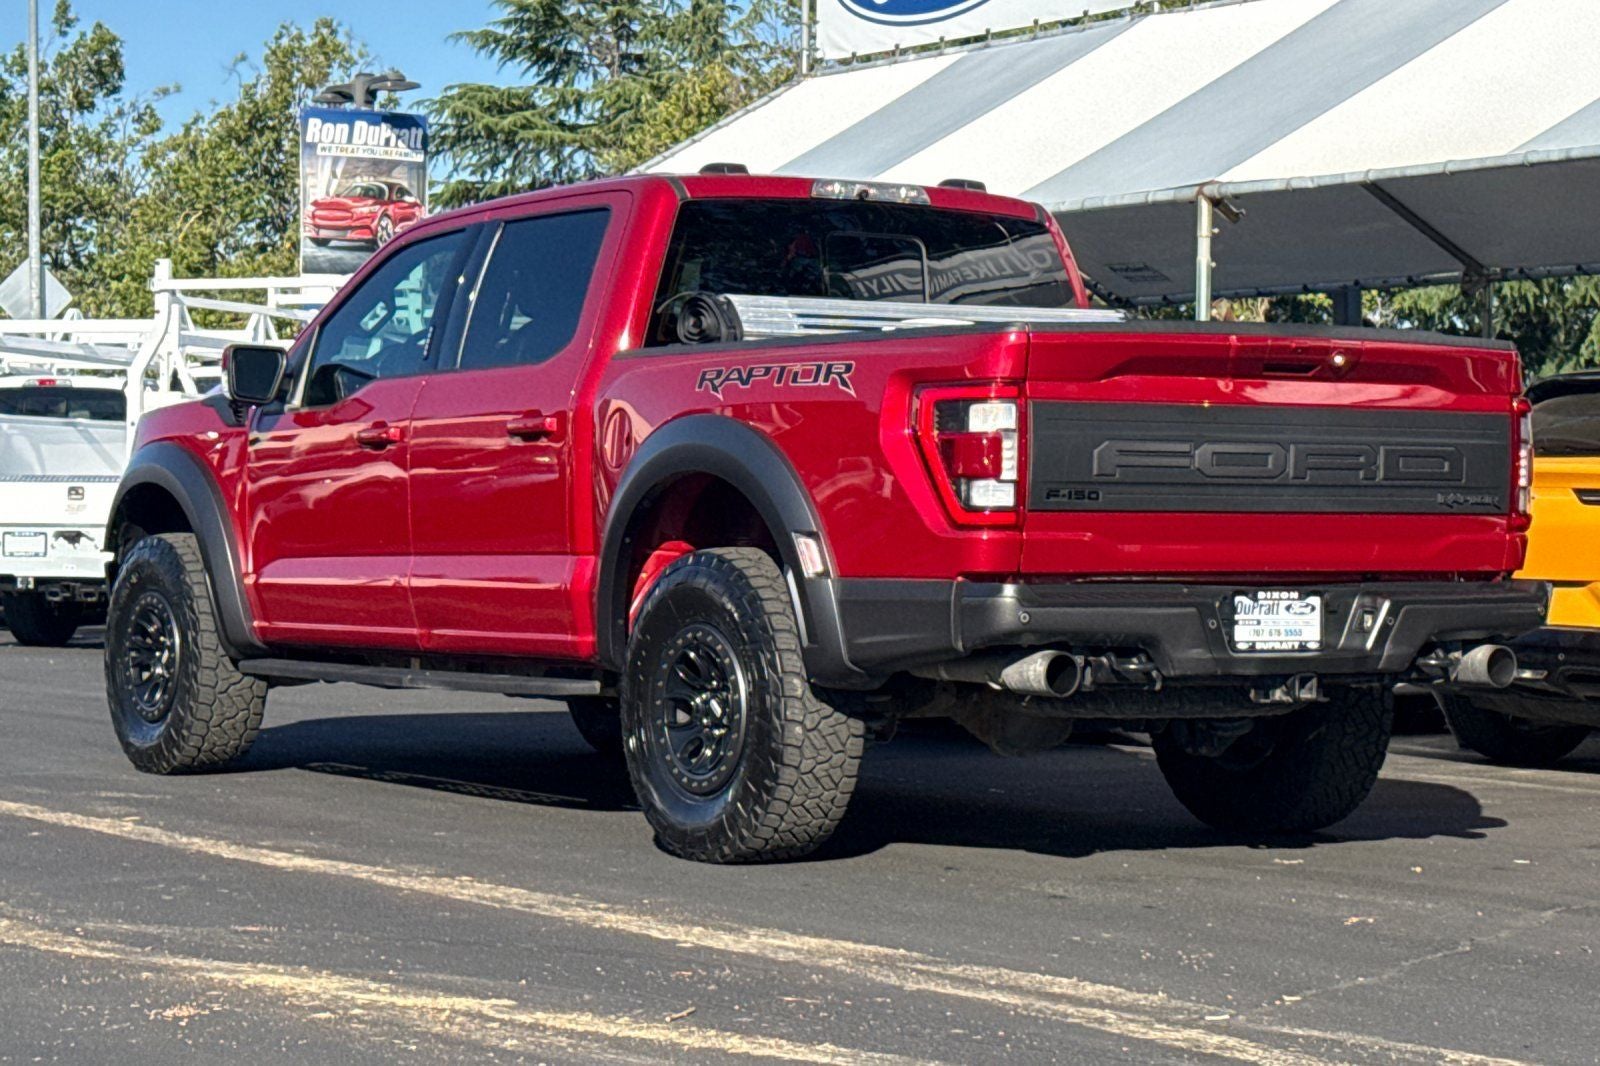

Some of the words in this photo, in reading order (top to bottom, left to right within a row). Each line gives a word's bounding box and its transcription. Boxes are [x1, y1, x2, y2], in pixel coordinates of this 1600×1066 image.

[305, 118, 349, 143] Ron
[352, 120, 424, 149] DuPratt
[335, 146, 360, 155] TREAT
[362, 147, 378, 156] YOU
[379, 148, 393, 156] LIKE
[695, 360, 857, 401] RAPTOR
[1092, 440, 1467, 483] FORD
[1046, 489, 1100, 501] F-150
[1257, 591, 1299, 599] DIXON
[1235, 601, 1280, 615] DuPratt
